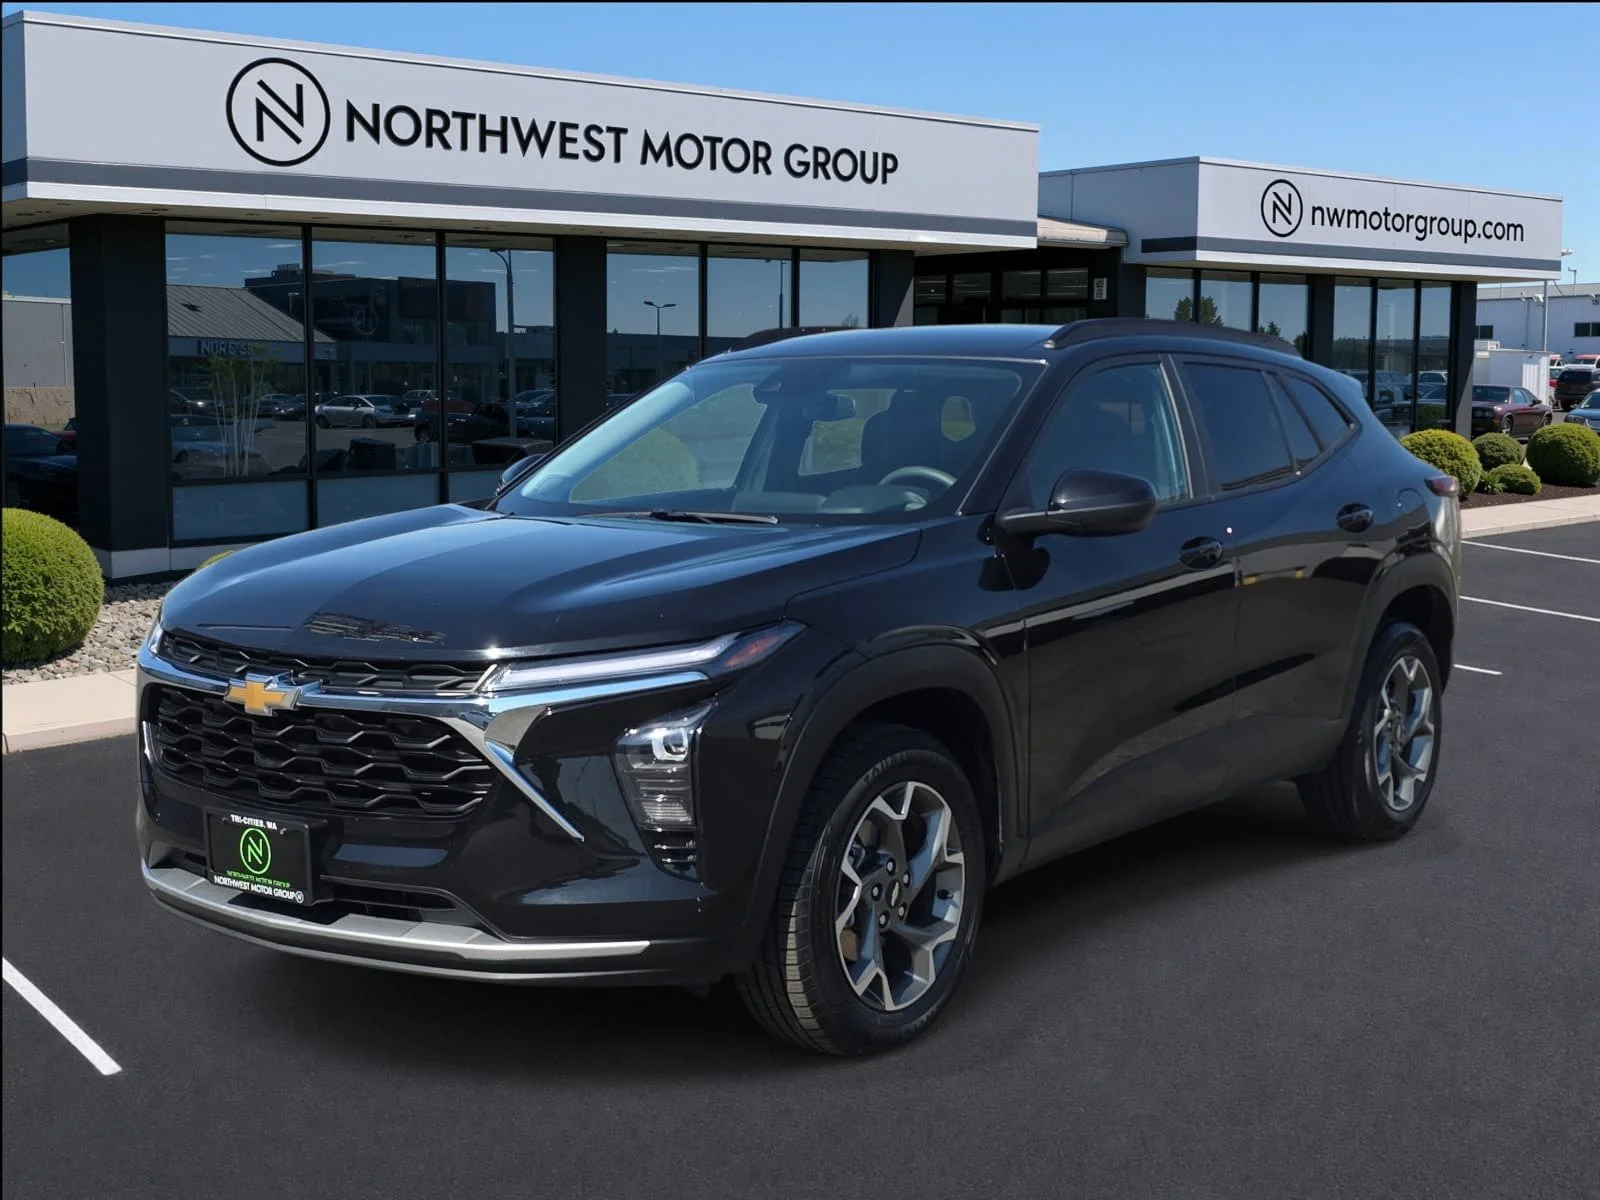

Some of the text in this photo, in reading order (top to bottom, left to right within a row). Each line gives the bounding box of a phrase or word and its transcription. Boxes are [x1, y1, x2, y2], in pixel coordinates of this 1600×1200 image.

[346, 98, 898, 184] NORTHWEST MOTOR GROUP
[1311, 205, 1524, 243] nwmotorgroup.com
[214, 875, 296, 900] NORTHWEST MOTOR GROUP
